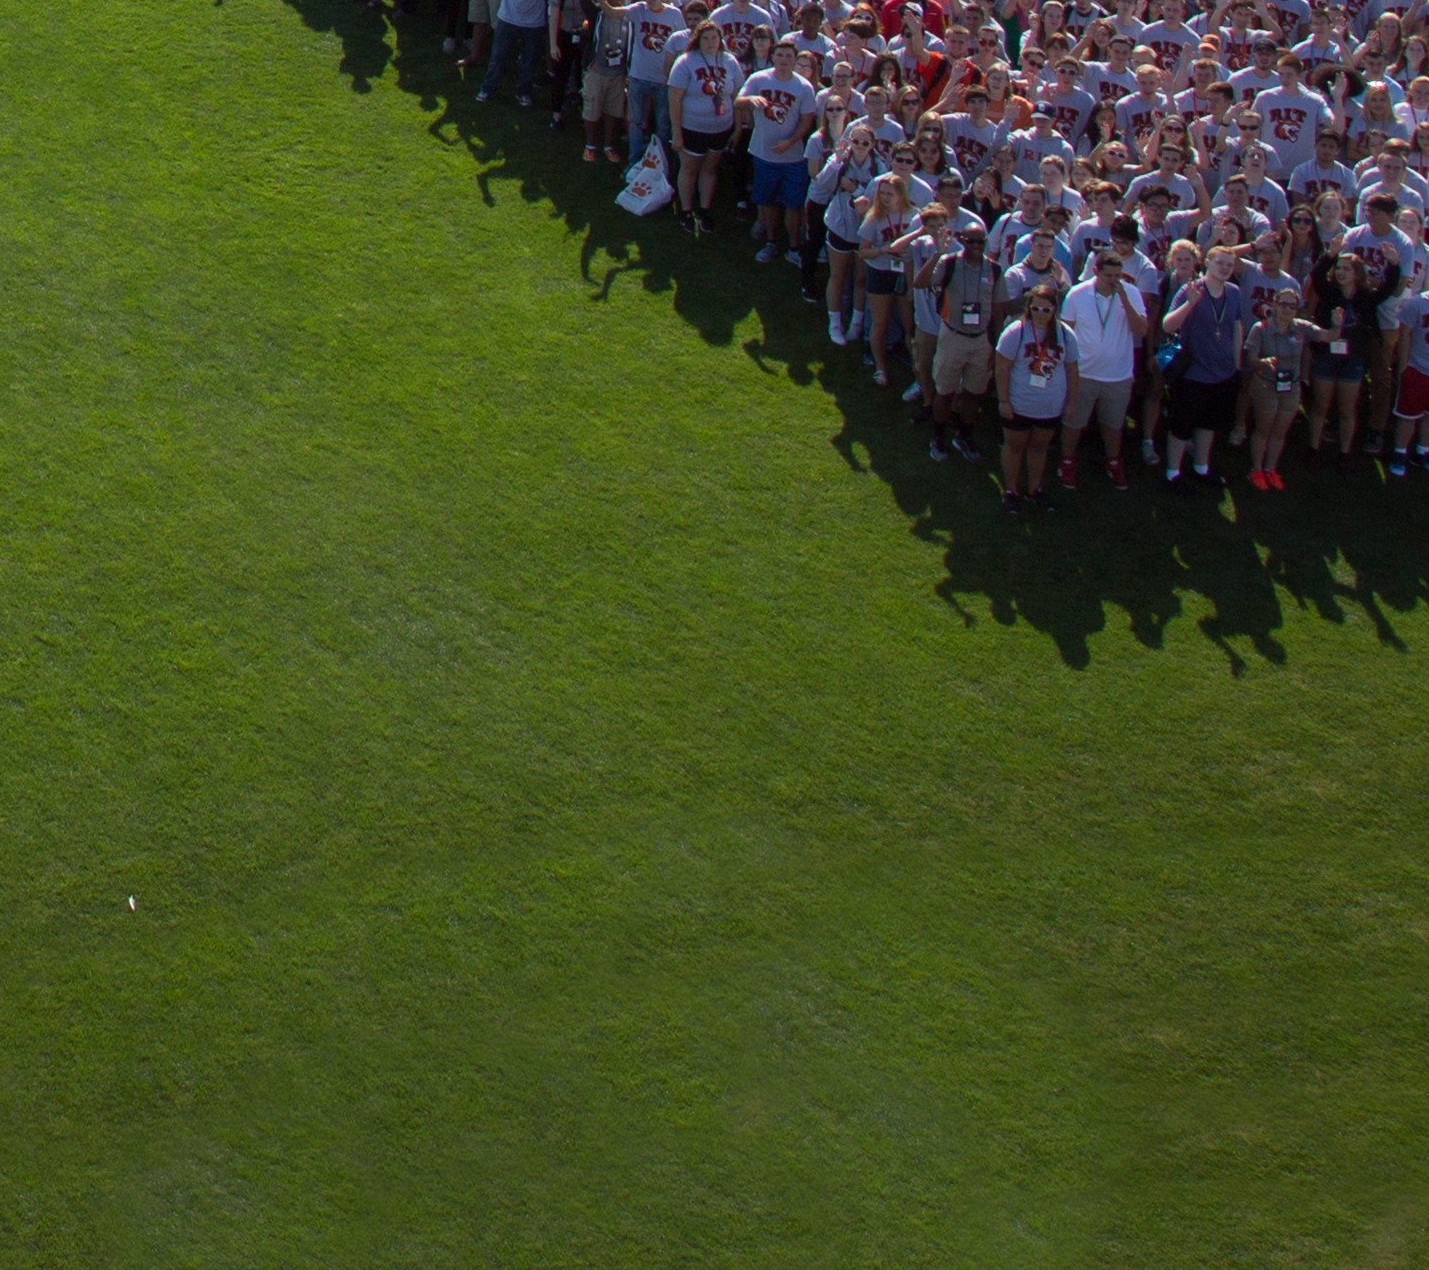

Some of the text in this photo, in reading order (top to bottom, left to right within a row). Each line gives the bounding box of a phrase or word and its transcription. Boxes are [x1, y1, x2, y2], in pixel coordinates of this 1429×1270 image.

[721, 22, 756, 37] RIT
[761, 89, 796, 106] RIT
[1270, 108, 1307, 127] RIT
